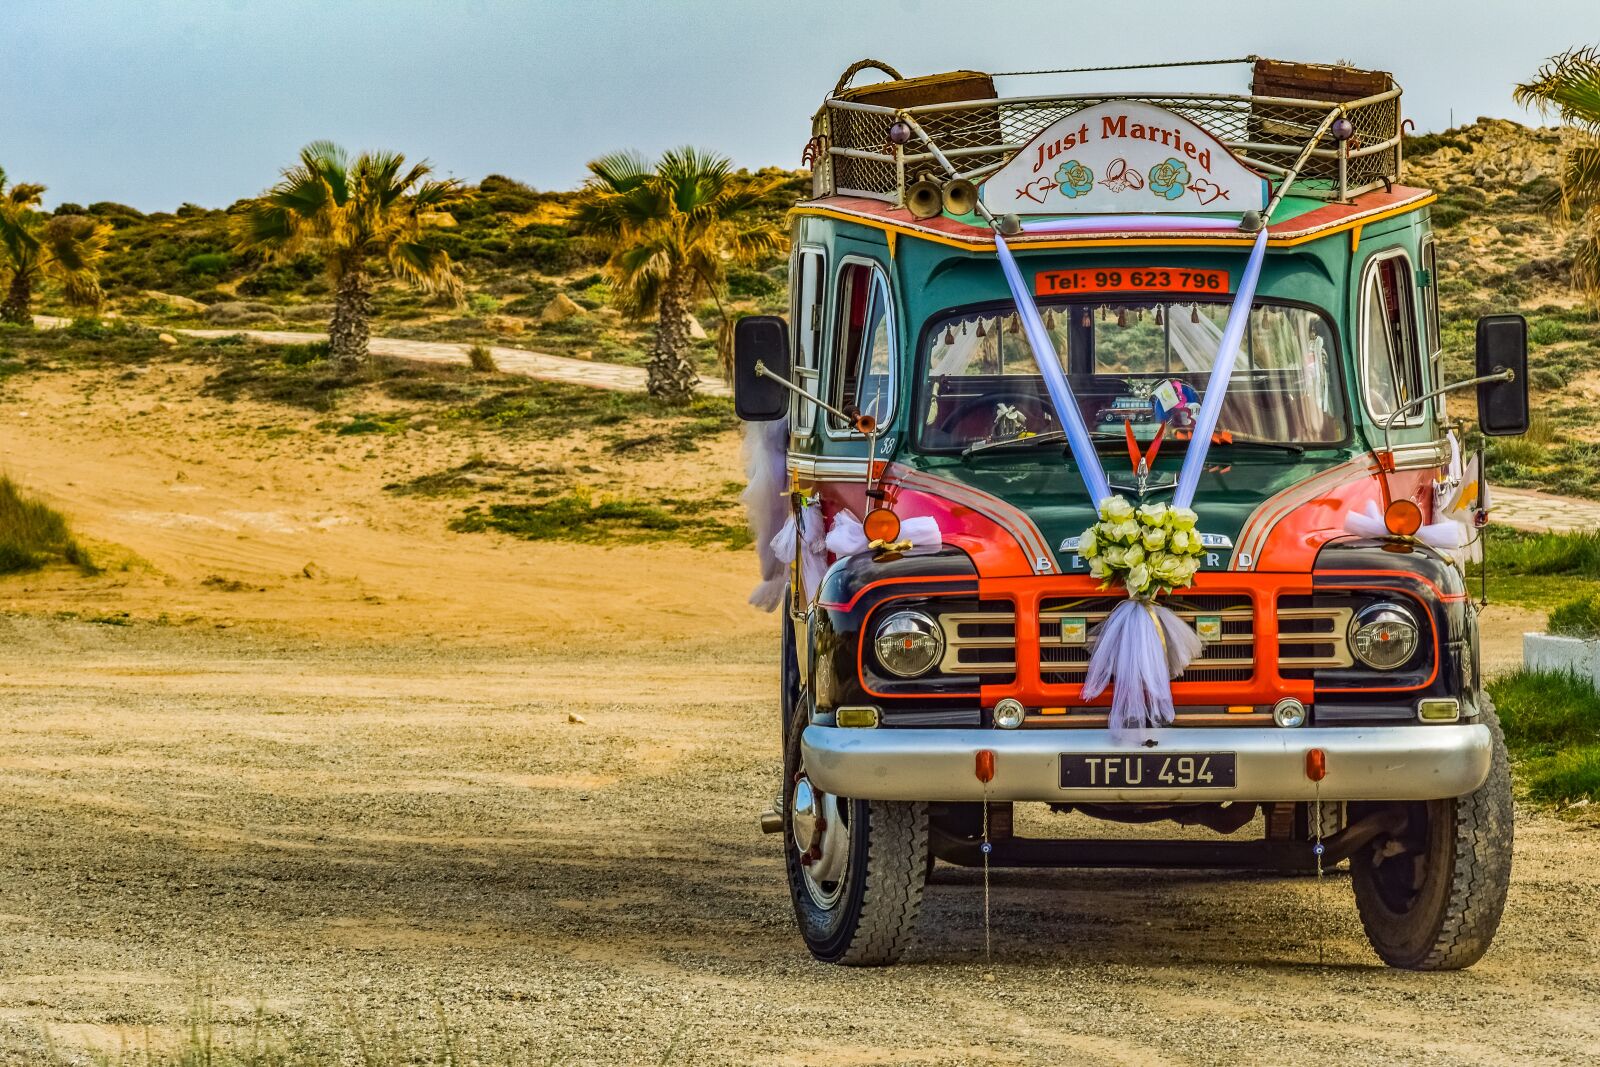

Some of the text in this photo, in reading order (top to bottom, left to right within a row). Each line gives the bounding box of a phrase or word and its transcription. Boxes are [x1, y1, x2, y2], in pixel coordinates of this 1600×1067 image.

[1033, 115, 1212, 174] Just Married
[1045, 271, 1220, 290] Tel: 99 623 796
[880, 437, 896, 455] 38
[1036, 552, 1253, 571] BERD
[1085, 757, 1214, 785] TFU 494
